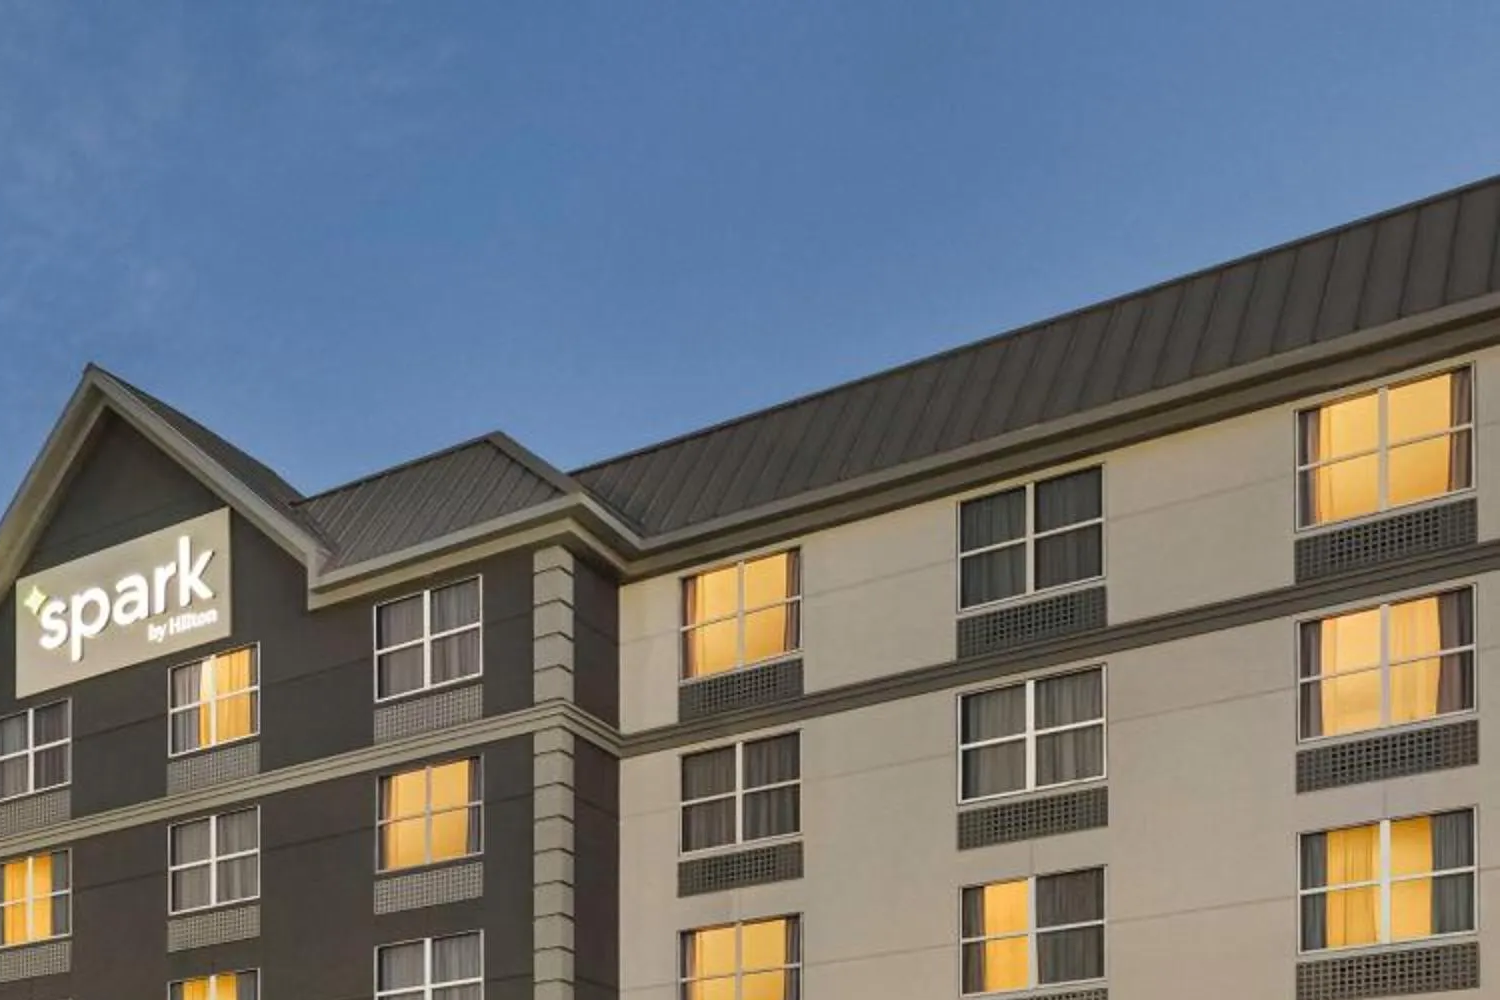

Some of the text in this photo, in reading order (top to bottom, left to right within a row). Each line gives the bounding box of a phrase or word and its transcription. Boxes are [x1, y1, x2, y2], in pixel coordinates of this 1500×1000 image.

[39, 535, 216, 662] spark
[147, 608, 218, 643] by Hilton
